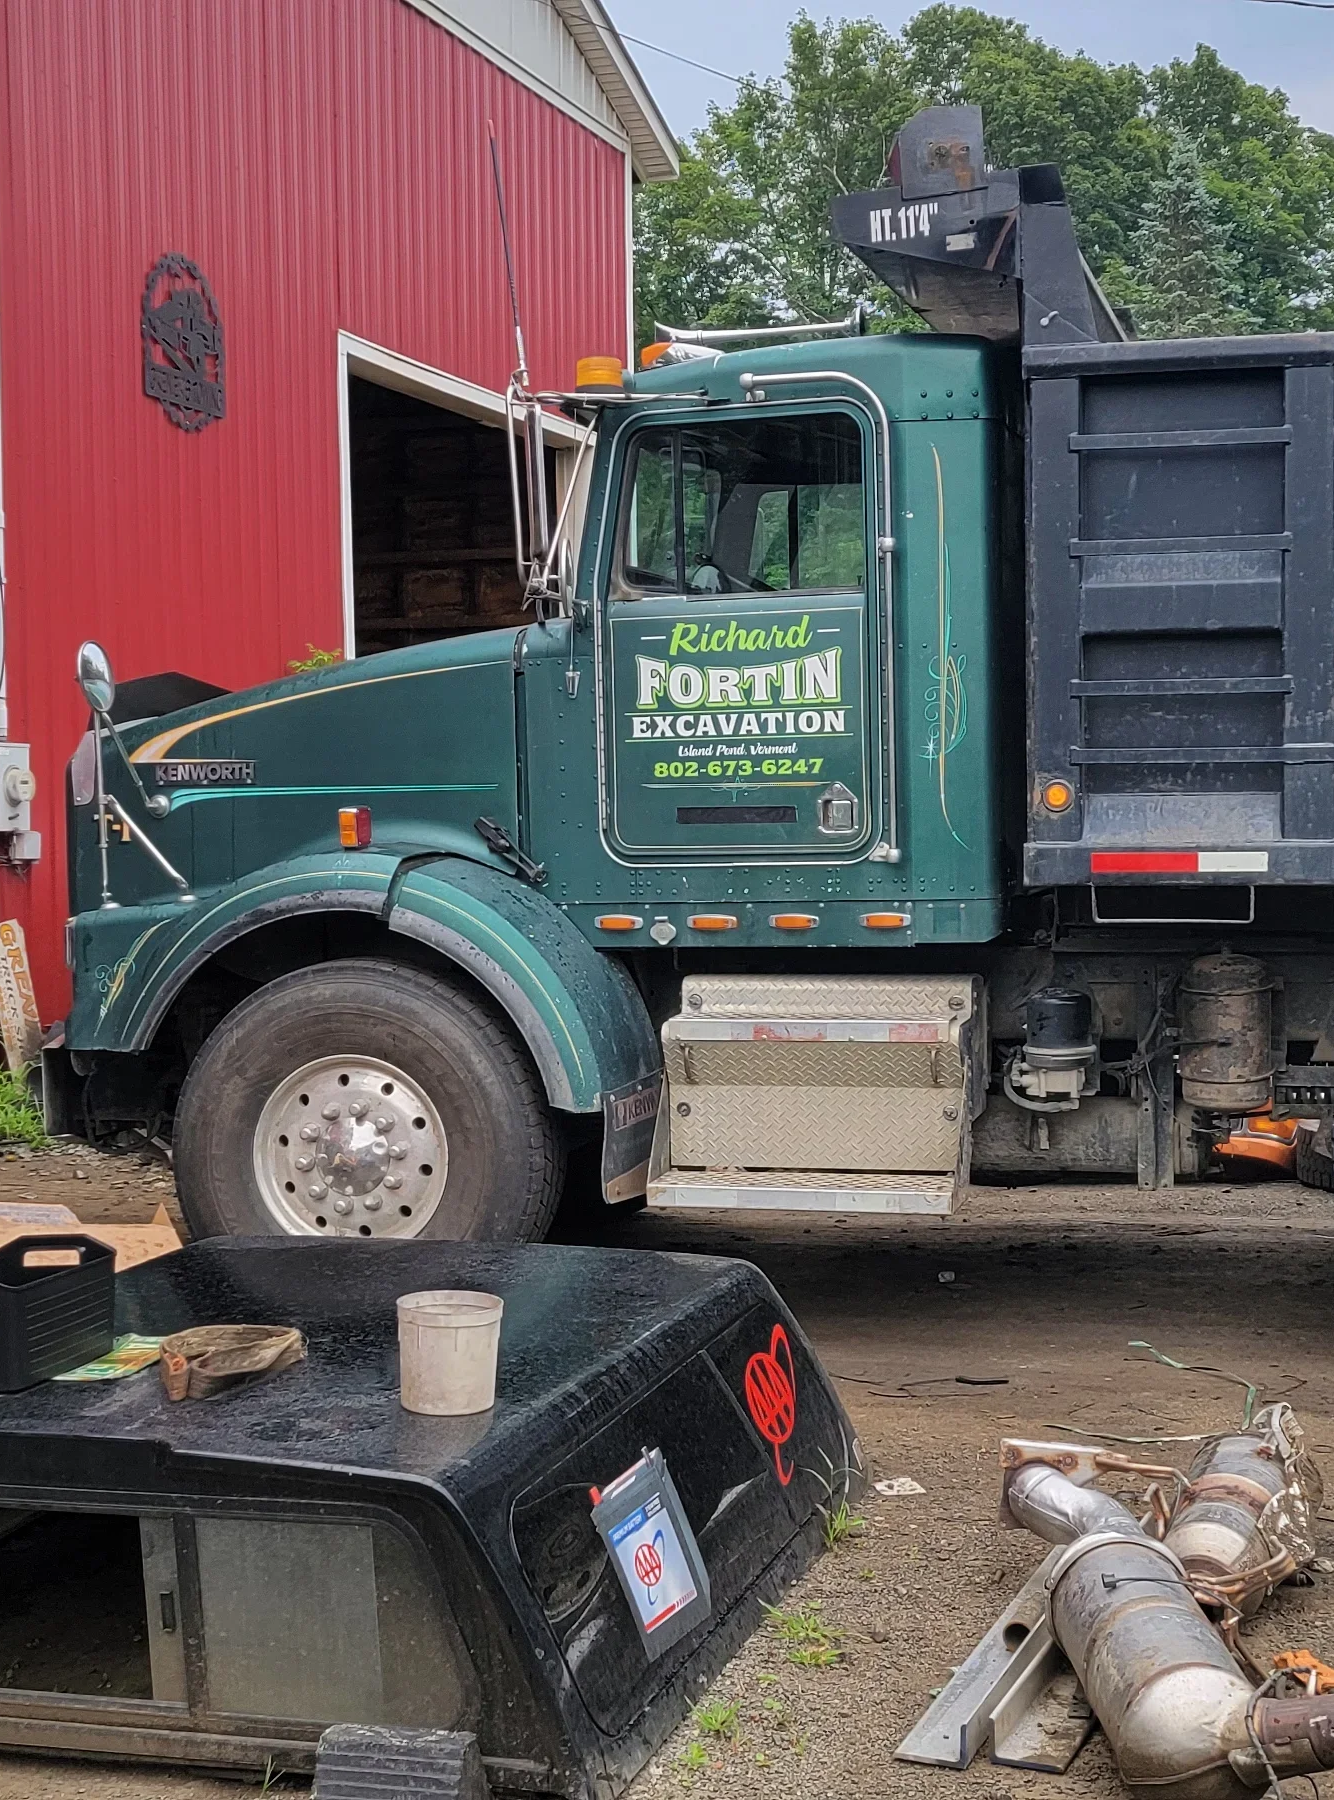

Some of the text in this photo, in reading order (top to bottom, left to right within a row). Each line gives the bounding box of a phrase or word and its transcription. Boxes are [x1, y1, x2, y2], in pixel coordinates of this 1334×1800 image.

[869, 202, 938, 243] HT. 11'4"
[669, 615, 813, 656] Richard
[635, 645, 842, 709] FORTIN
[632, 710, 845, 738] EXCAVATION
[678, 743, 714, 757] Island
[750, 742, 798, 756] Vermont
[155, 763, 255, 781] KENWORTH
[654, 758, 824, 778] 802-673-6247
[628, 1091, 656, 1121] KENW
